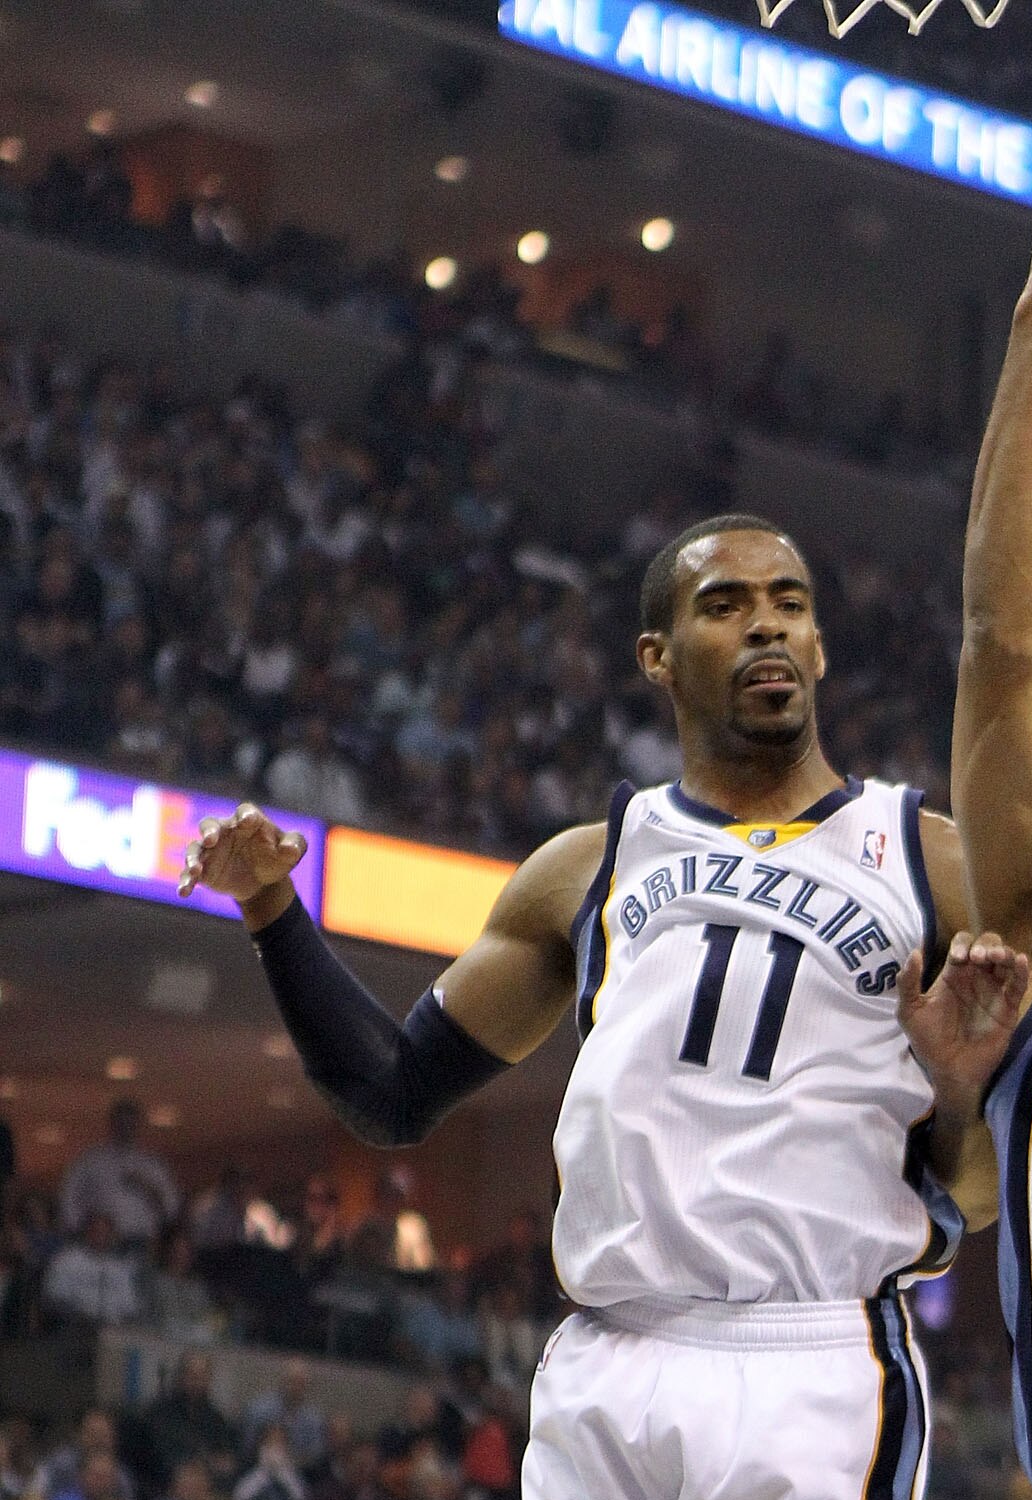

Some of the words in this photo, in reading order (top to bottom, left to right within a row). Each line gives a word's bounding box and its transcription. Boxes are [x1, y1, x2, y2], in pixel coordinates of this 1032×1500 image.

[615, 2, 838, 131] AIRLINE
[839, 74, 919, 152] OF
[23, 761, 194, 880] FedE
[618, 852, 901, 997] GRIZZLIES
[679, 922, 805, 1082] 11
